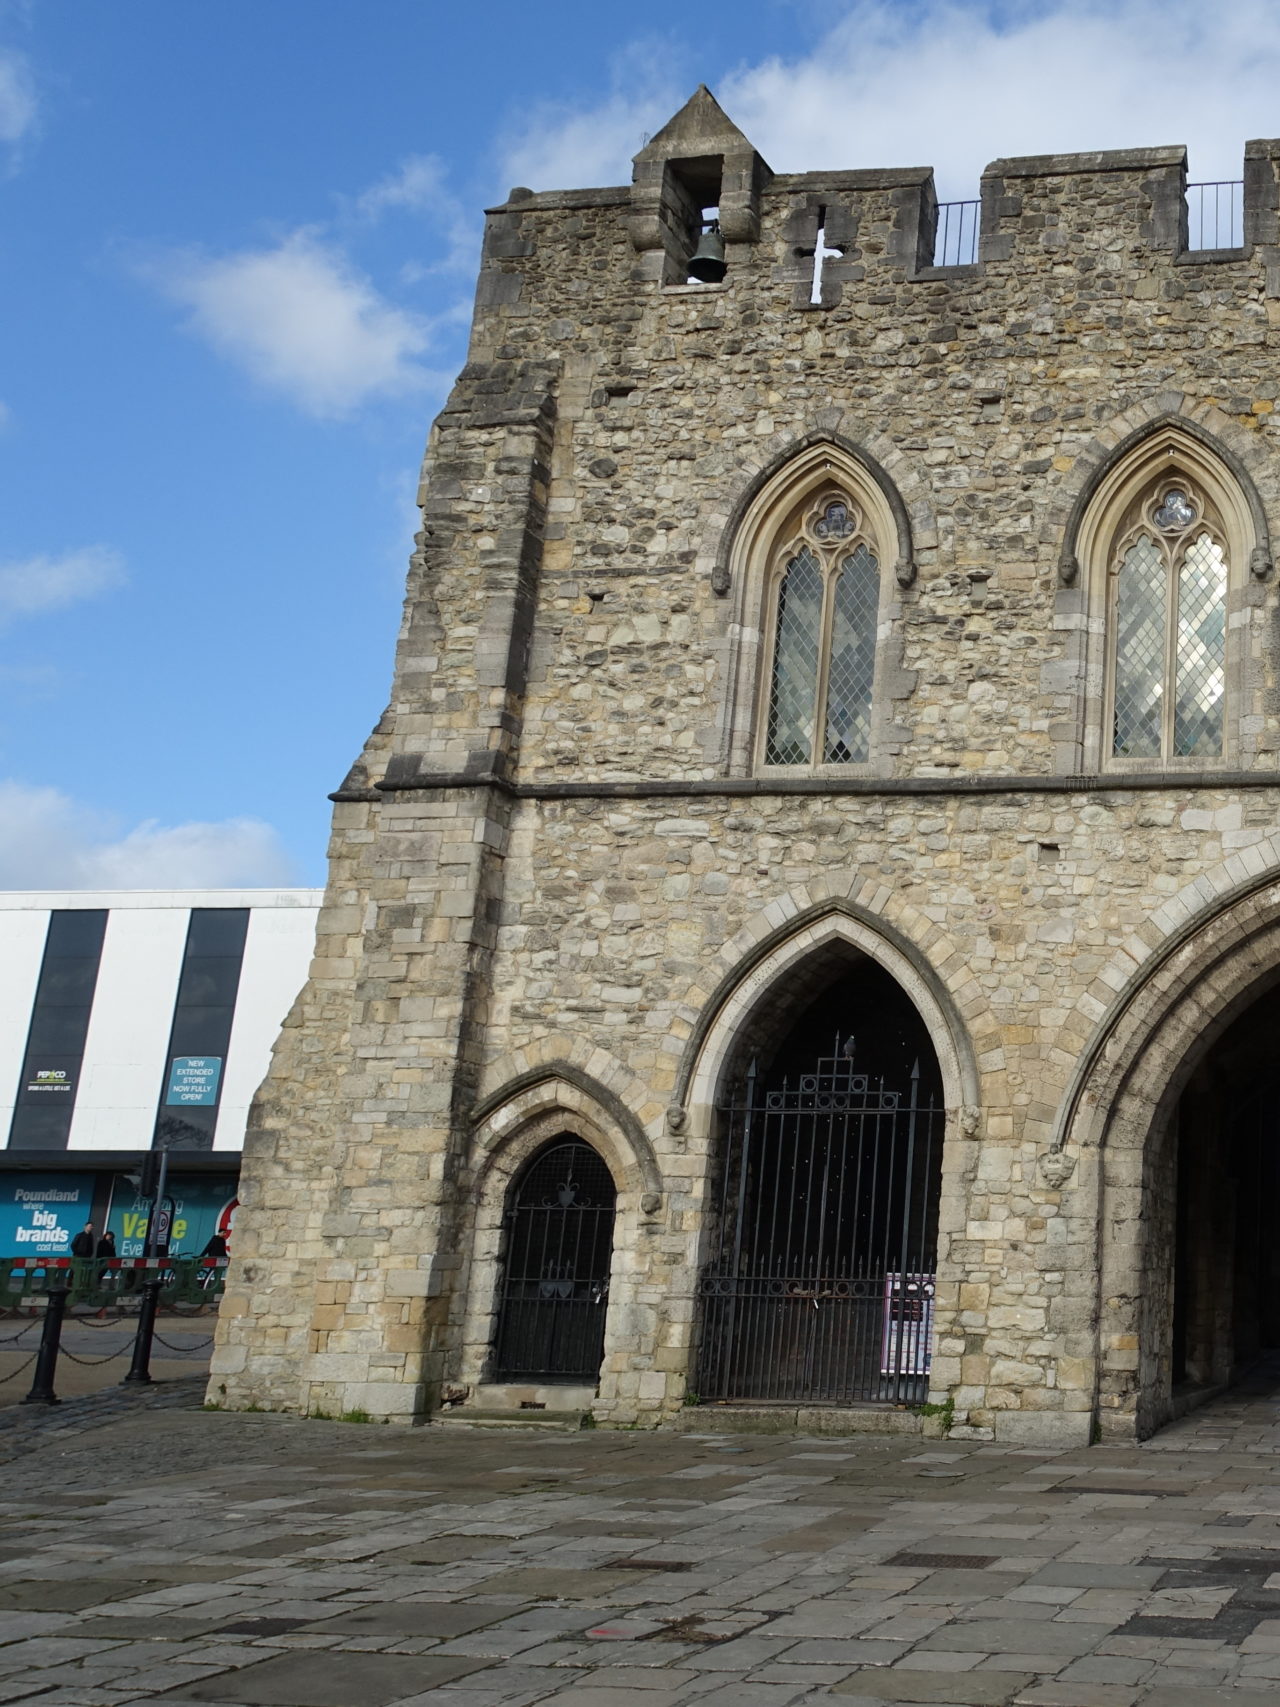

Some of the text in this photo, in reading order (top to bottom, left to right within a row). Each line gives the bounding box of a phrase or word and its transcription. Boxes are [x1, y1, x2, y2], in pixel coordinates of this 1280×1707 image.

[14, 1188, 79, 1201] Poundland
[32, 1210, 57, 1229] big
[122, 1213, 187, 1239] Vae
[16, 1226, 69, 1242] brands
